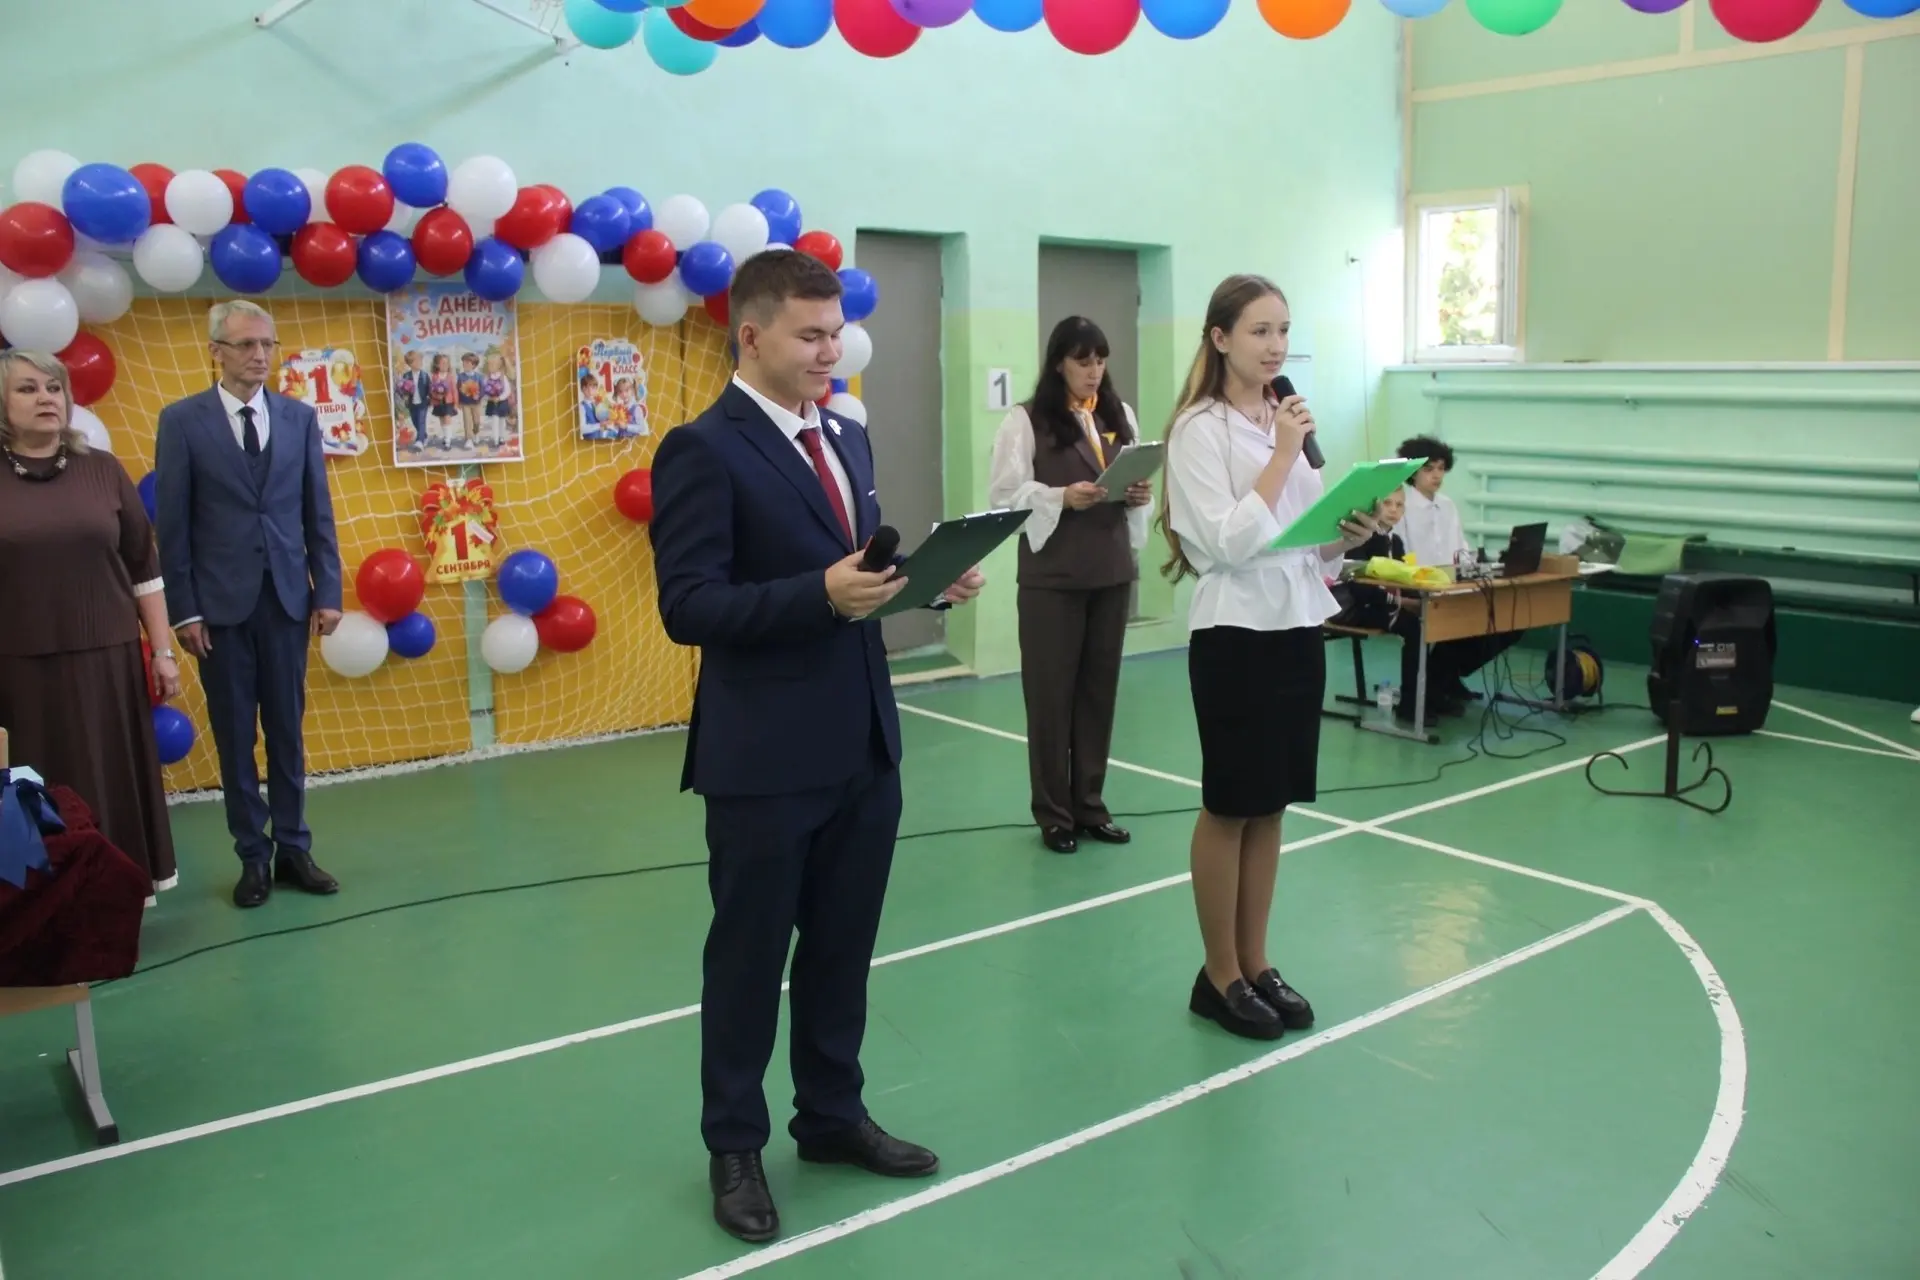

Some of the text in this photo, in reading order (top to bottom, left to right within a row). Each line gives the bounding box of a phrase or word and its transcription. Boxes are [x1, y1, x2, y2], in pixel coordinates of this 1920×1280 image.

[418, 292, 492, 316] С ДНЁМ
[414, 315, 504, 339] ЗНАНИЙ!
[308, 364, 332, 403] 1
[598, 361, 612, 392] 1
[613, 365, 638, 374] КЛАСС
[993, 372, 1007, 407] 1
[316, 403, 347, 414] ТЯБРЯ
[451, 522, 468, 560] 1
[436, 560, 490, 575] СЕНТЯБРЯ
